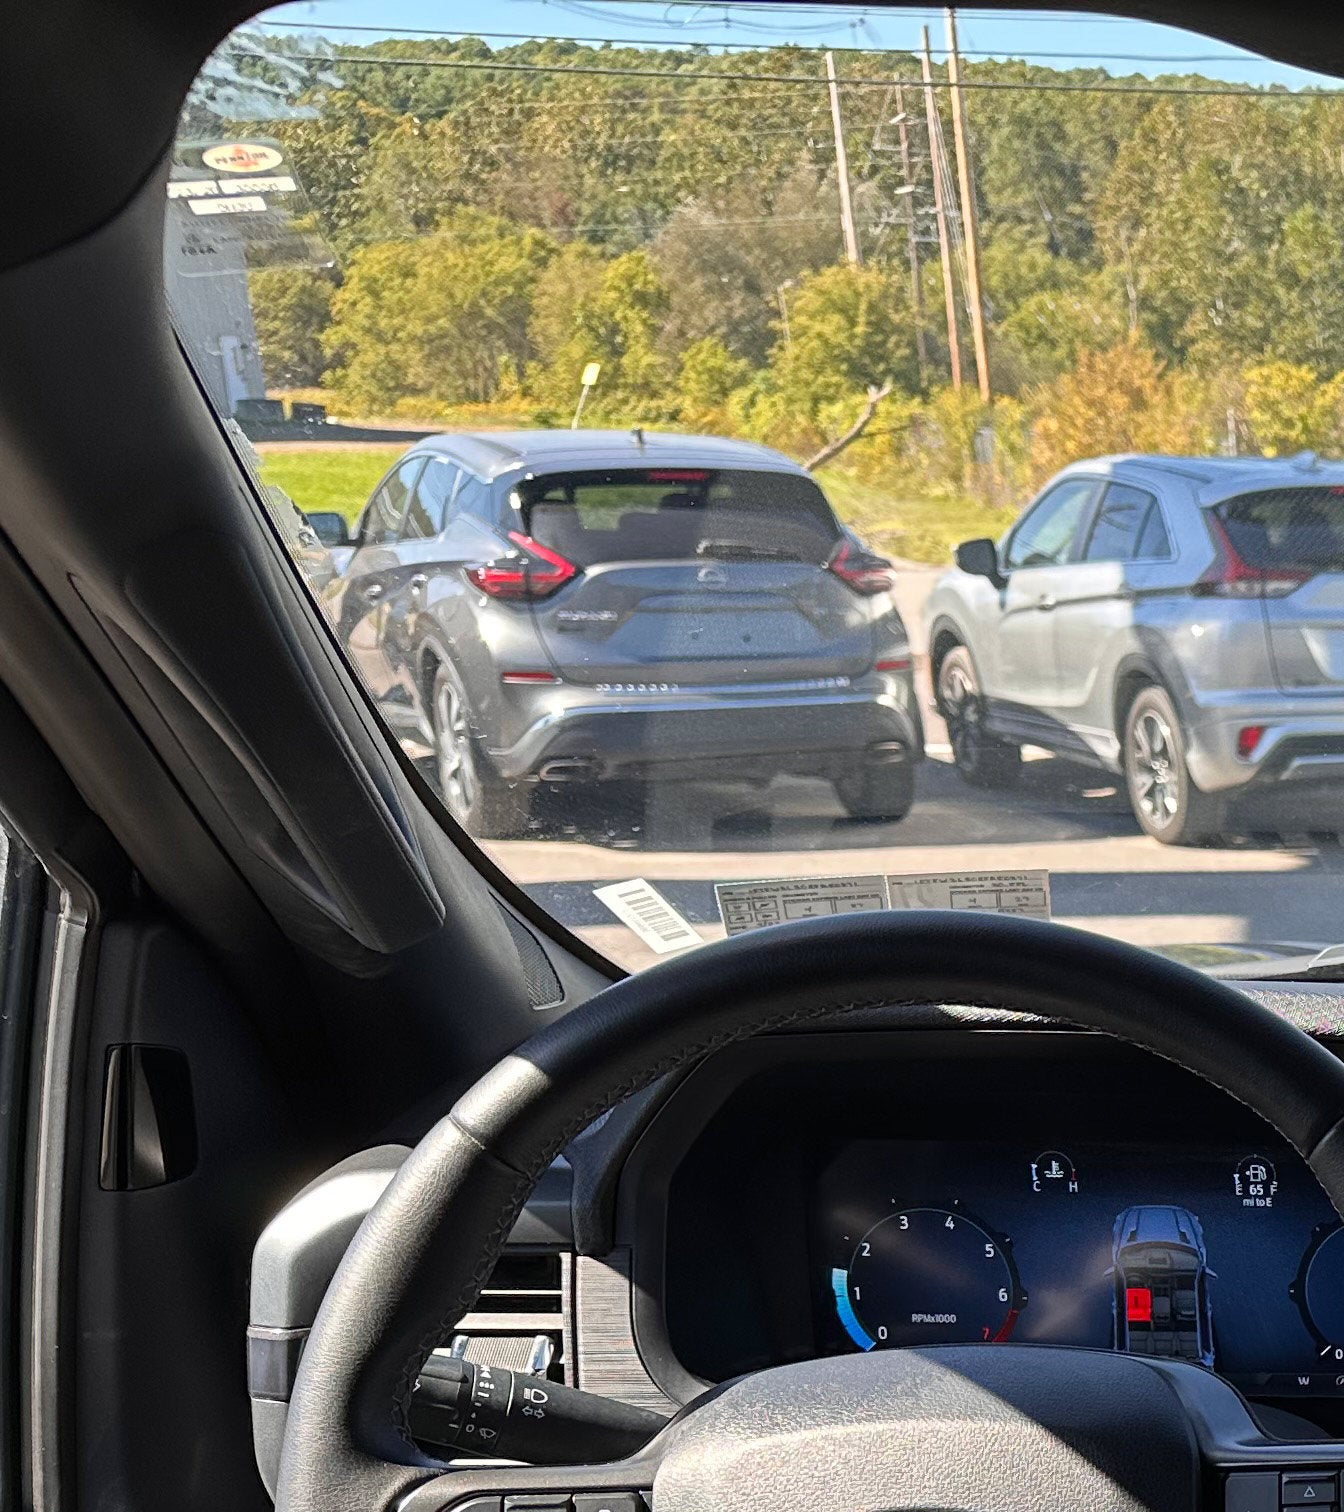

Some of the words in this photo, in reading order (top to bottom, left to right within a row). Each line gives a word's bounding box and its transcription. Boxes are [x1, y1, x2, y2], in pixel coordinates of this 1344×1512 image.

[1033, 1181, 1041, 1192] C
[1069, 1181, 1078, 1193] H
[1249, 1184, 1264, 1196] 65
[900, 1216, 909, 1230] 3
[945, 1216, 955, 1230] 4
[861, 1242, 871, 1257] 2
[985, 1243, 995, 1258] 5
[854, 1286, 861, 1300] 1
[998, 1288, 1008, 1302] 6
[878, 1326, 888, 1340] 0
[982, 1327, 991, 1340] 7
[1335, 1348, 1344, 1360] 0
[1298, 1376, 1310, 1386] W
